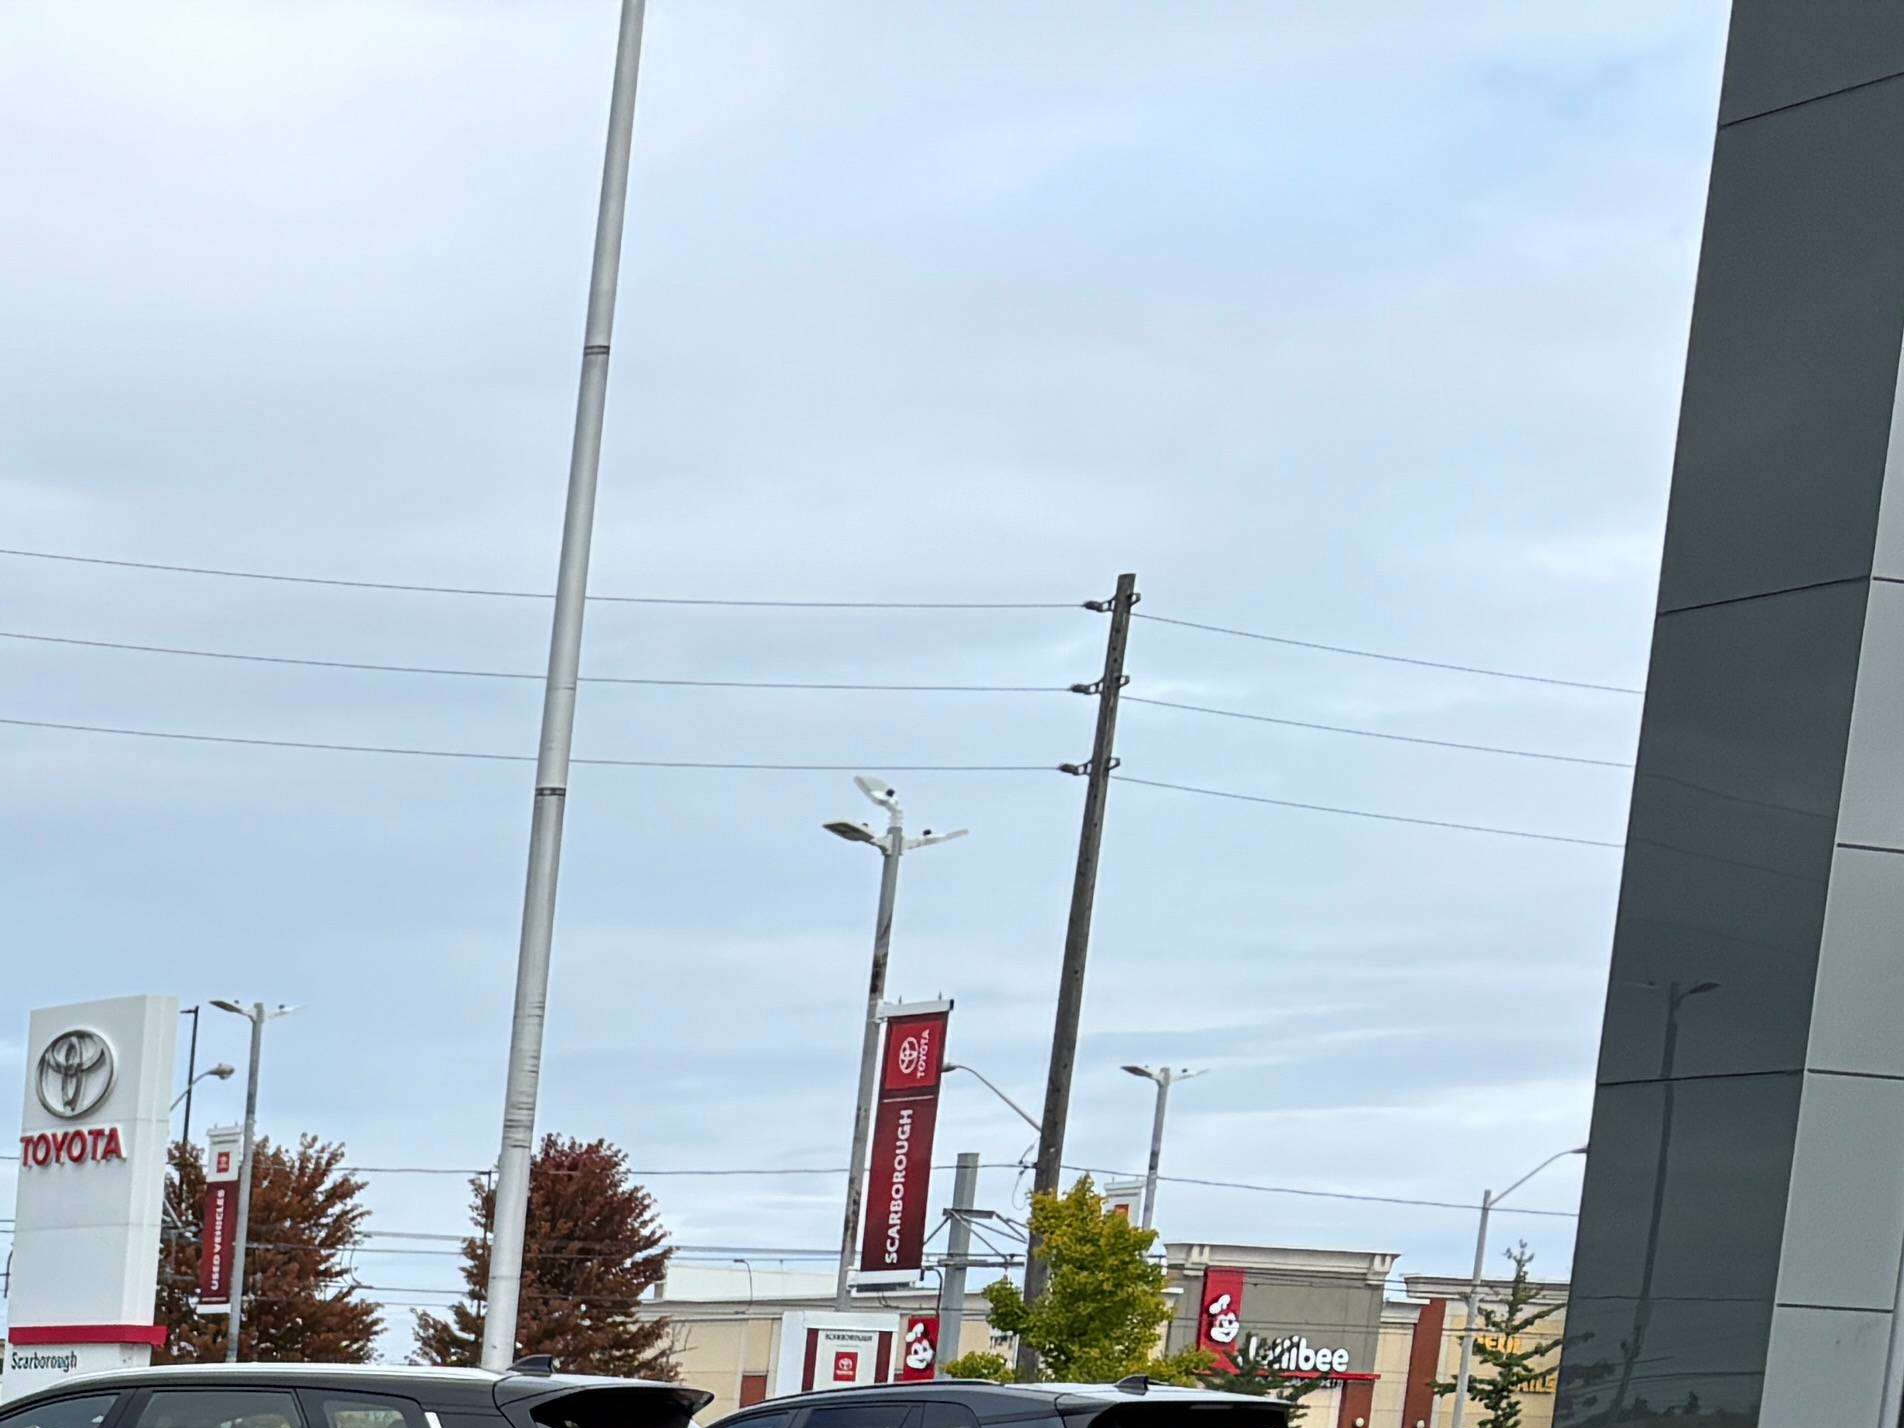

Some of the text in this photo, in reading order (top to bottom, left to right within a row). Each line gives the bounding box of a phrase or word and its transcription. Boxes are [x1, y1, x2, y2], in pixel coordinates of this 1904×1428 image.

[916, 1028, 930, 1079] TOYOTA
[20, 1126, 125, 1168] TOYOTA
[885, 1108, 914, 1264] SCARBOROUGH
[11, 1350, 78, 1373] Scarborough
